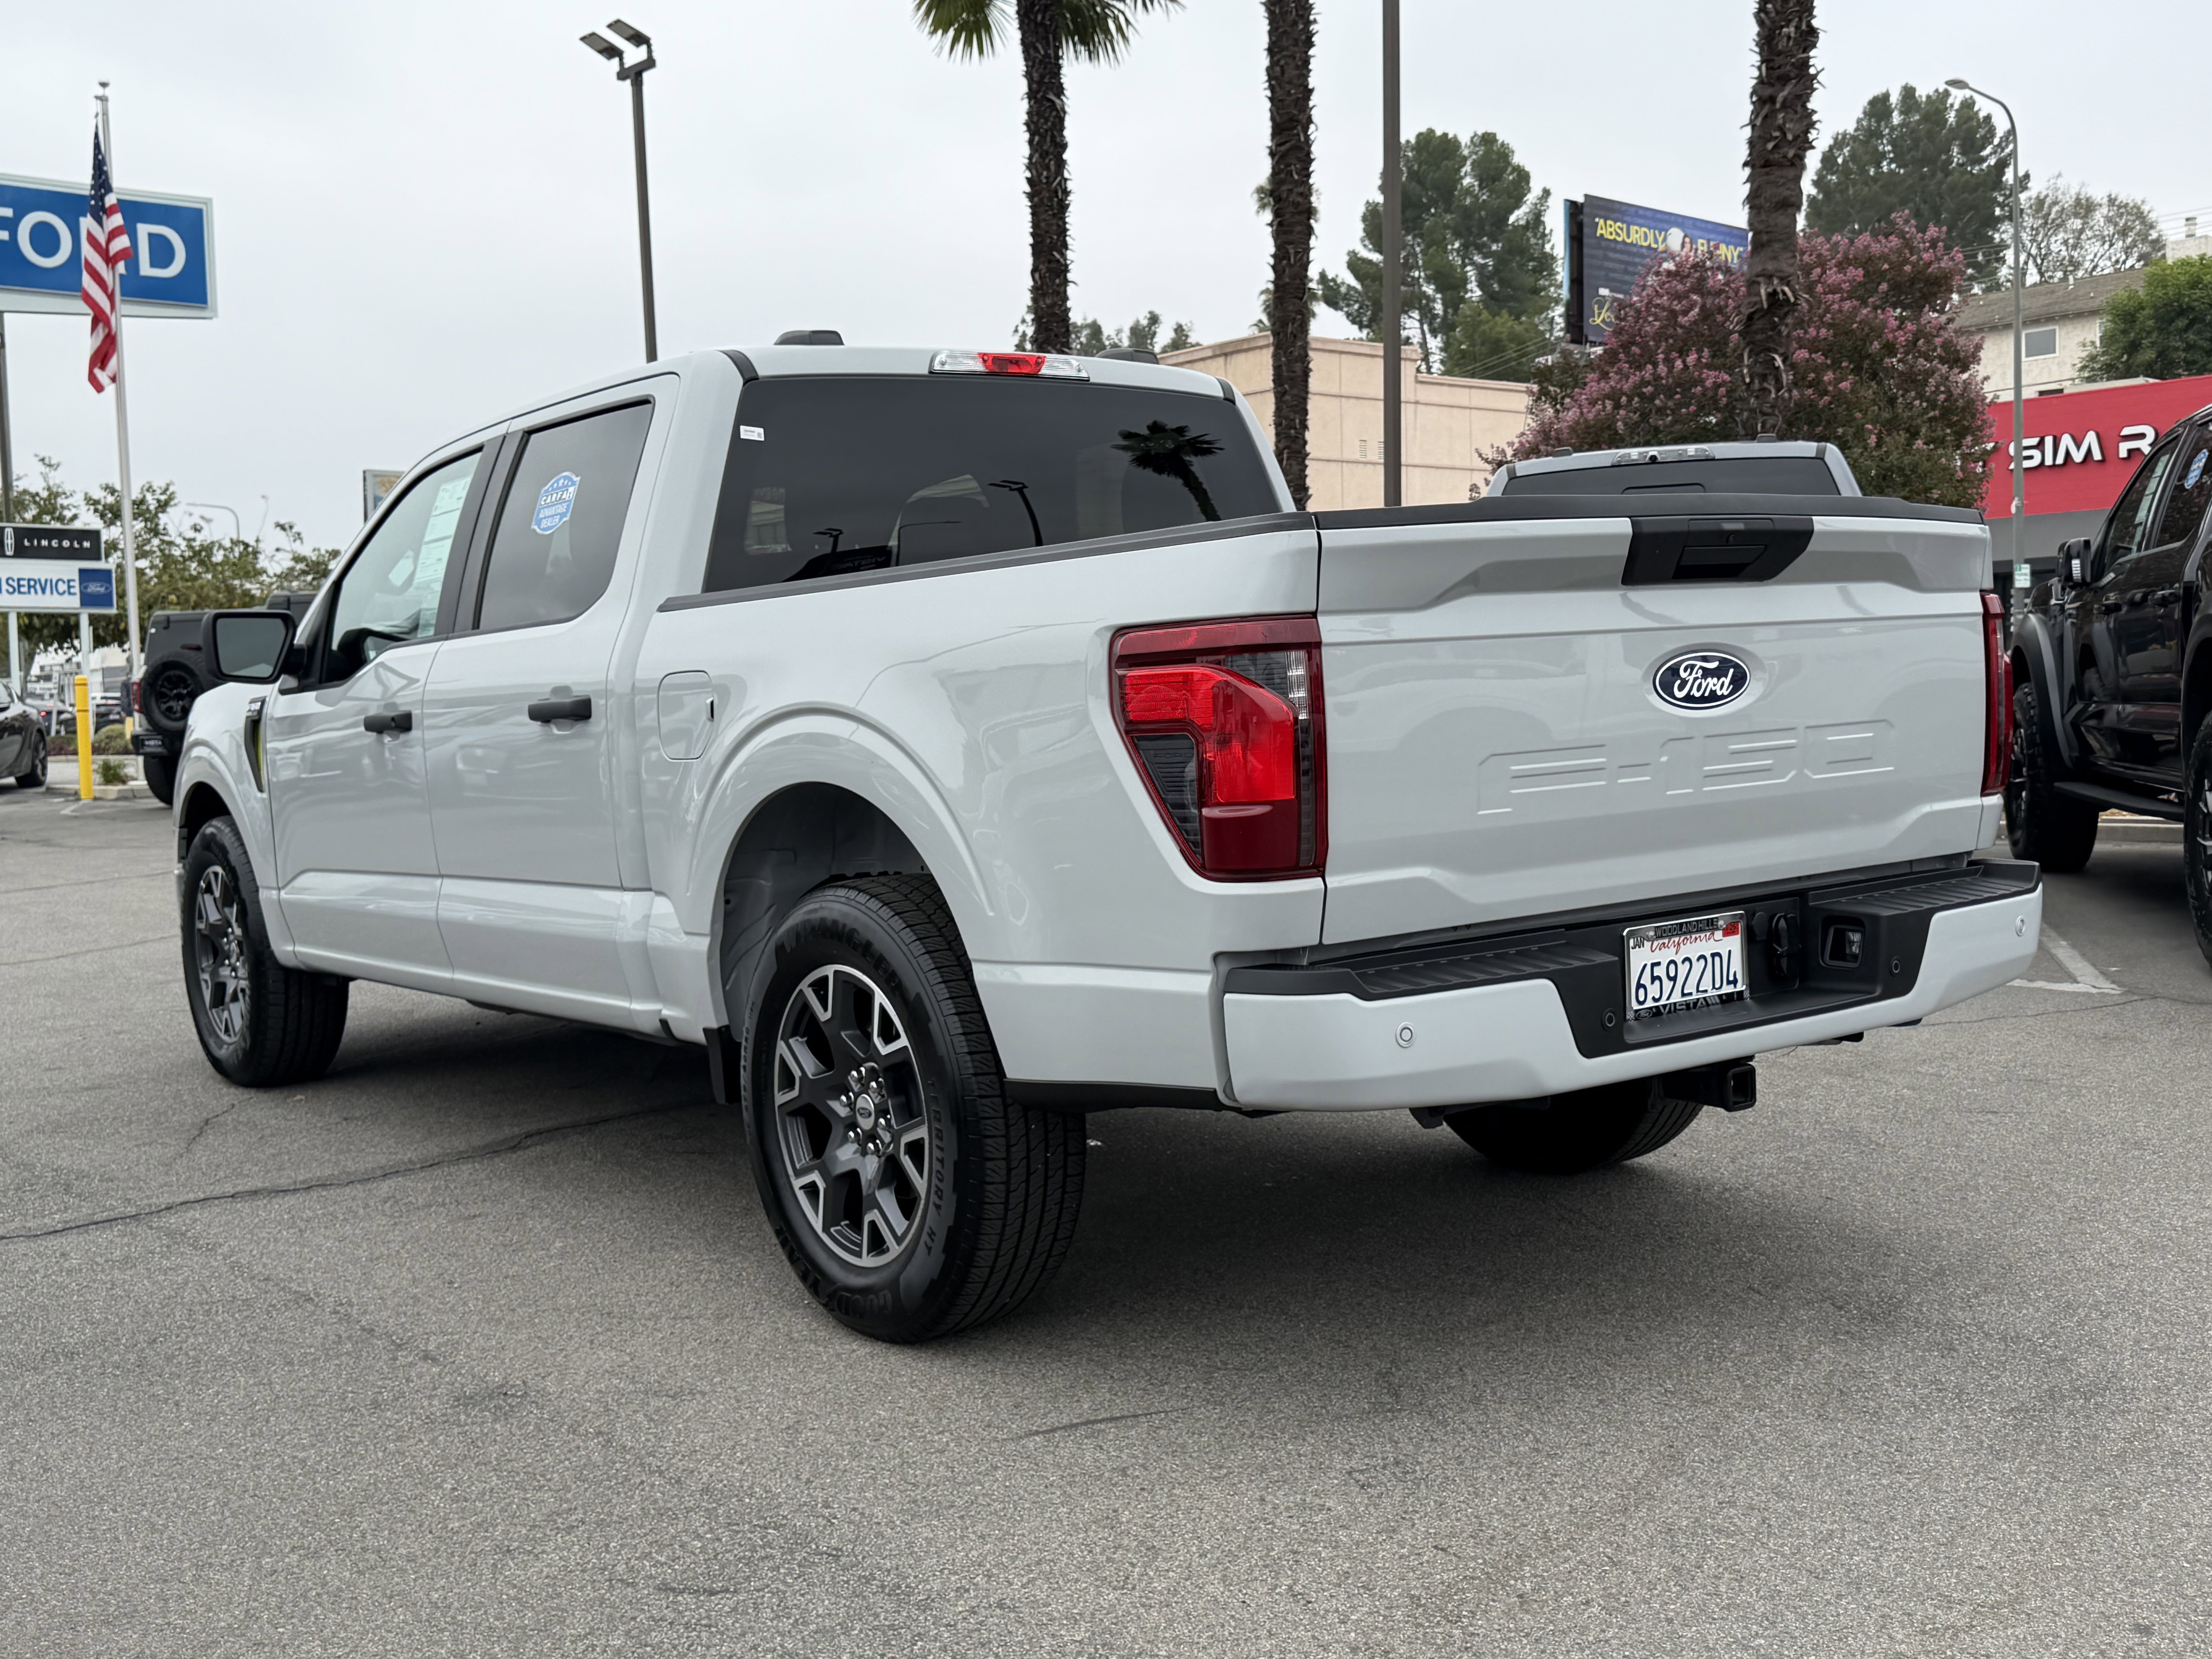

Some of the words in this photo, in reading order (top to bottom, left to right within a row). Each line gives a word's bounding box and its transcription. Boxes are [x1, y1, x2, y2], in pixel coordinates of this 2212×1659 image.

[0, 207, 186, 278] OD
[2008, 430, 2103, 470] SIM
[23, 538, 91, 549] LINCOLN
[5, 577, 77, 596] SERVICE
[1673, 659, 1734, 698] Ford
[1477, 720, 1895, 814] F-150
[1631, 937, 1645, 949] JAN
[1650, 931, 1723, 955] California
[1656, 922, 1697, 937] WOODLAND
[1698, 919, 1718, 931] HILLS
[1635, 949, 1738, 1005] 65922D4
[927, 1078, 945, 1216] TERRITORY
